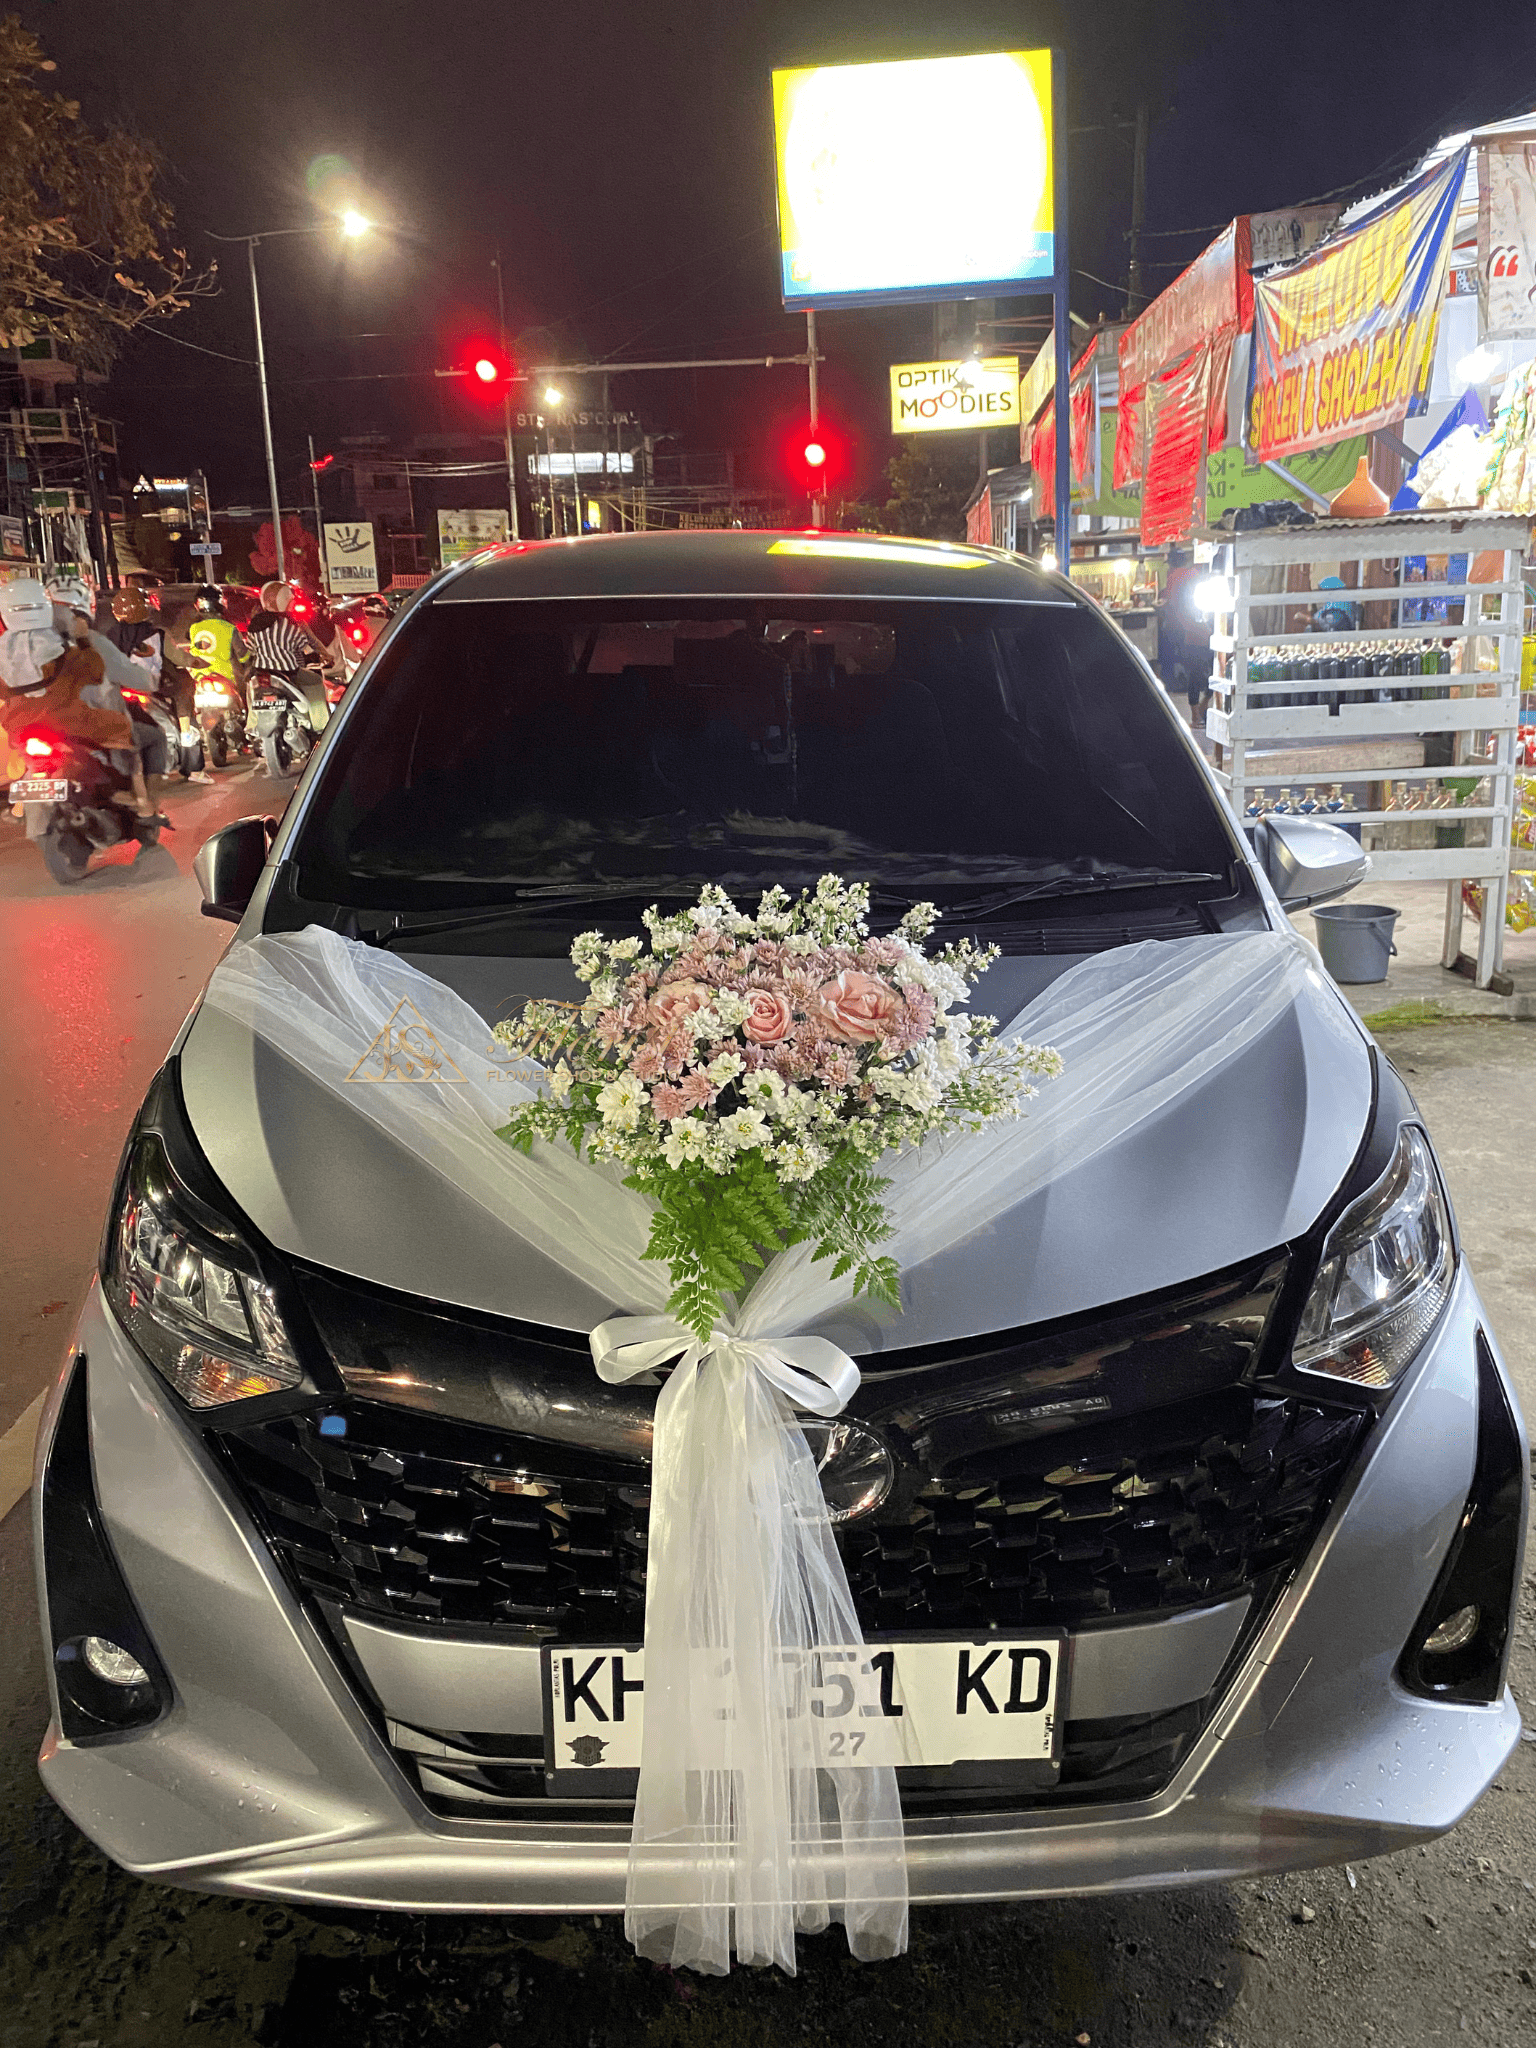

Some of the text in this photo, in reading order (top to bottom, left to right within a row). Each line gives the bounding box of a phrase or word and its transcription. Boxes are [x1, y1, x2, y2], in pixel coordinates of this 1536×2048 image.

[899, 368, 961, 388] OPTIK
[900, 390, 1011, 418] MOODIES
[1250, 371, 1302, 450] SHOLEH
[1302, 364, 1316, 435] &
[956, 1648, 1052, 1715] KD
[828, 1731, 866, 1757] 27
